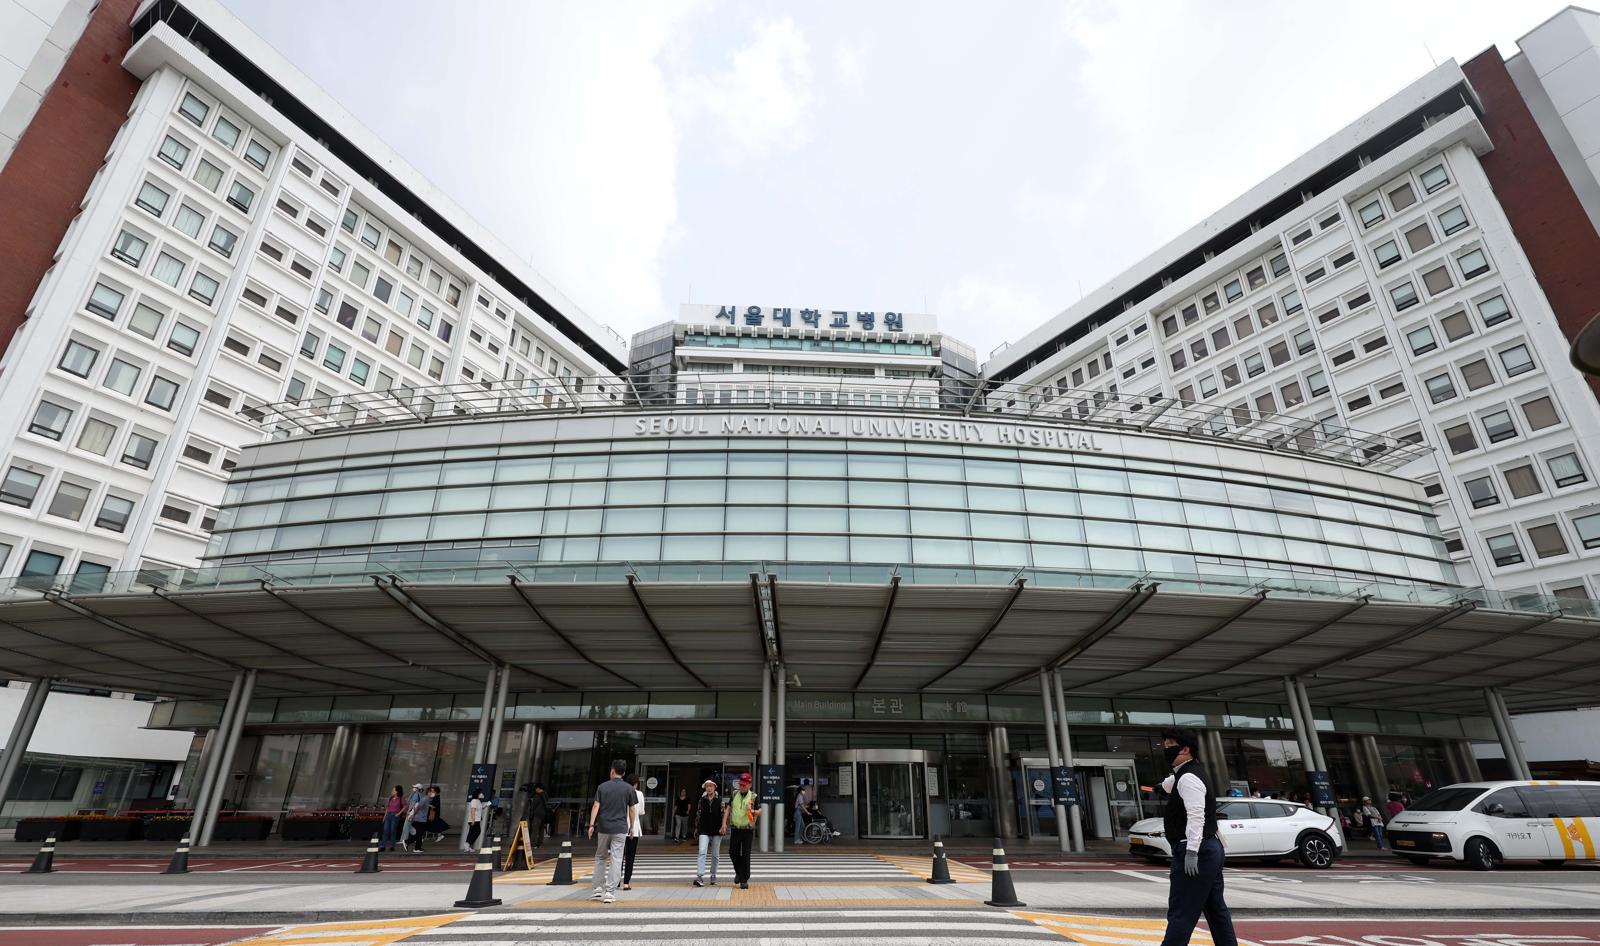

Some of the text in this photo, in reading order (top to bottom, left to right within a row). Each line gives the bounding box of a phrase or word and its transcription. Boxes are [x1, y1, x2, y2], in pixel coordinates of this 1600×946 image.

[715, 305, 904, 332] 서울대학교병원
[634, 415, 1103, 451] SEOUL NATIONAL UNIVERSITY HOSPITAL
[872, 698, 903, 714] 본관
